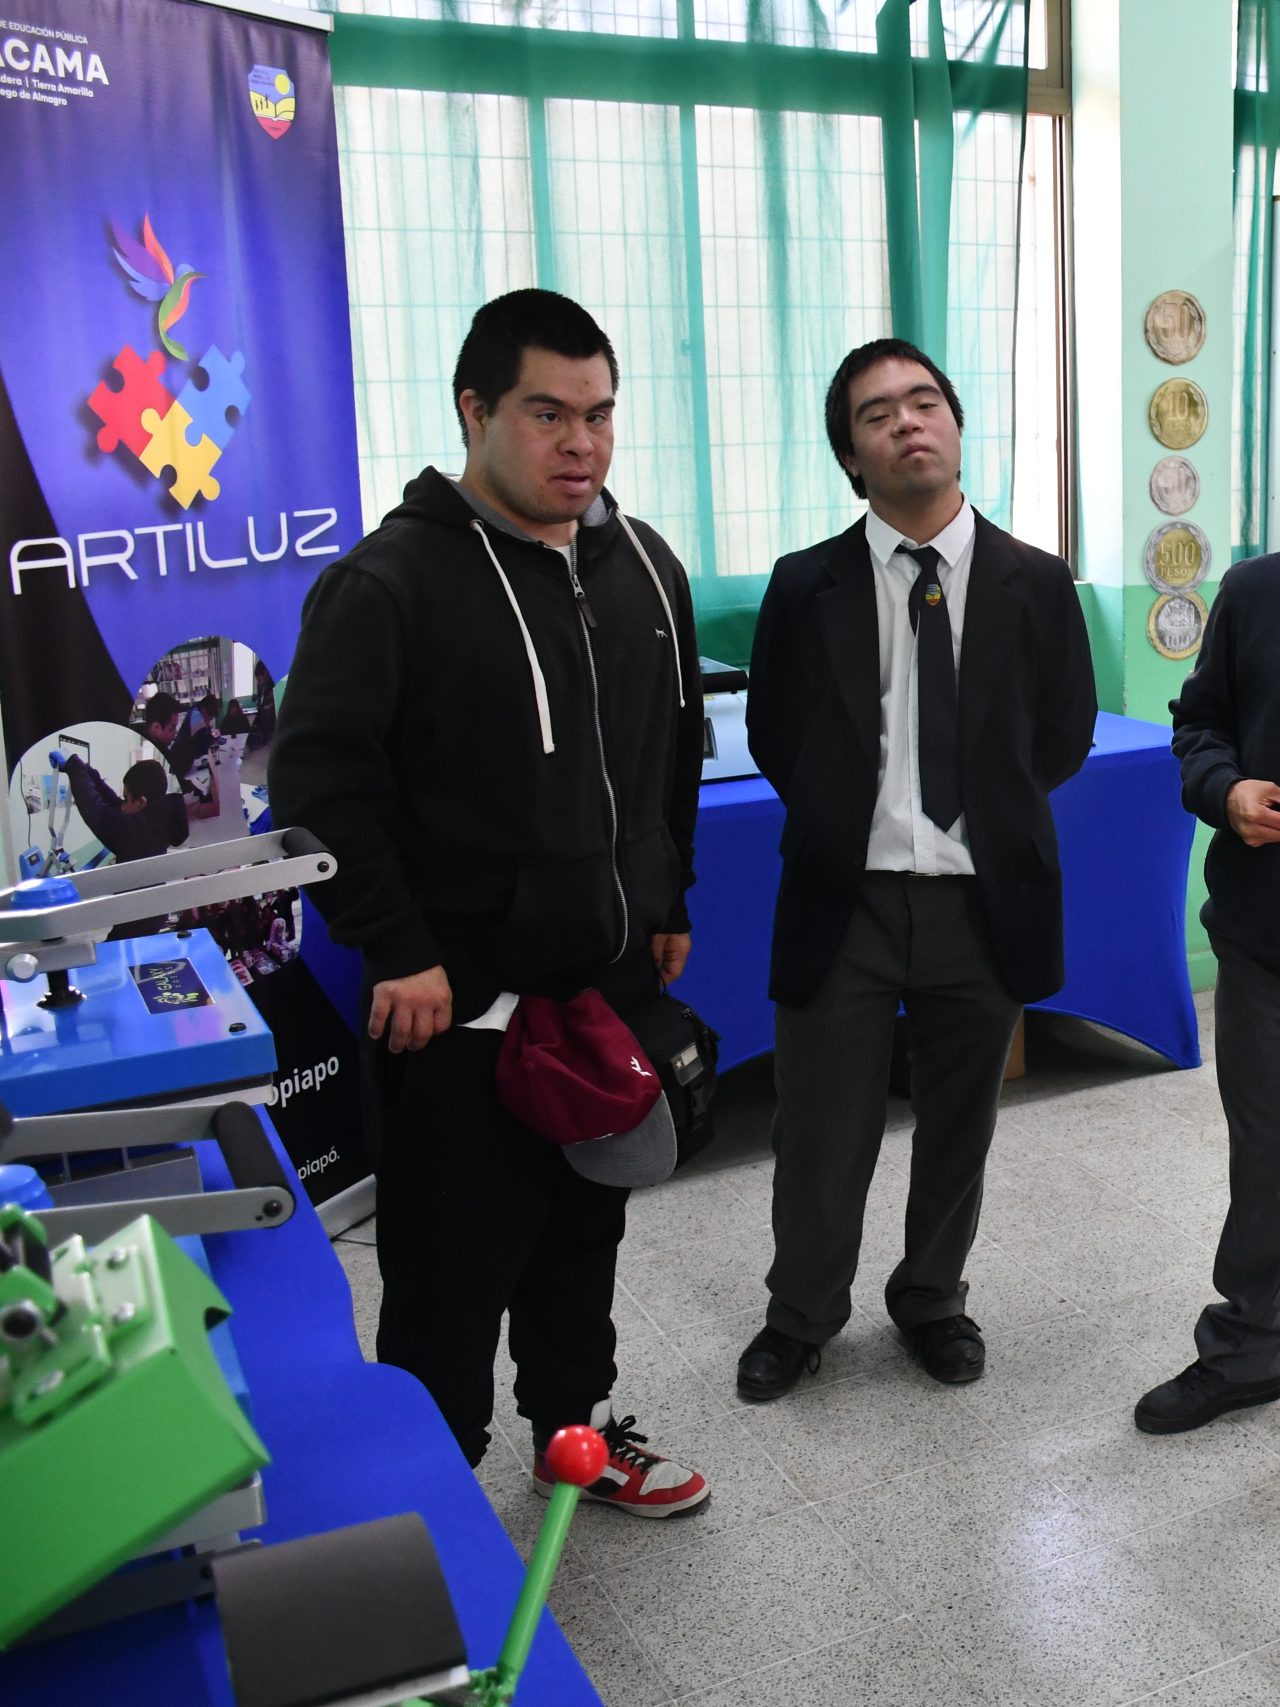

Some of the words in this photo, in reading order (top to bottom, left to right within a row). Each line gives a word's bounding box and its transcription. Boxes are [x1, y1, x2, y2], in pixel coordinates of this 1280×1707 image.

[9, 22, 55, 38] EDUCACIÓN
[56, 30, 88, 45] PÚBLICA
[0, 38, 110, 86] CAMA
[19, 90, 31, 100] de
[32, 91, 68, 107] Almagro
[31, 78, 57, 92] Tierra
[58, 83, 95, 98] Amarilla
[1167, 391, 1188, 421] 10
[10, 507, 340, 595] ARTILUZ
[1160, 541, 1195, 567] 500
[1161, 566, 1193, 578] PESOS
